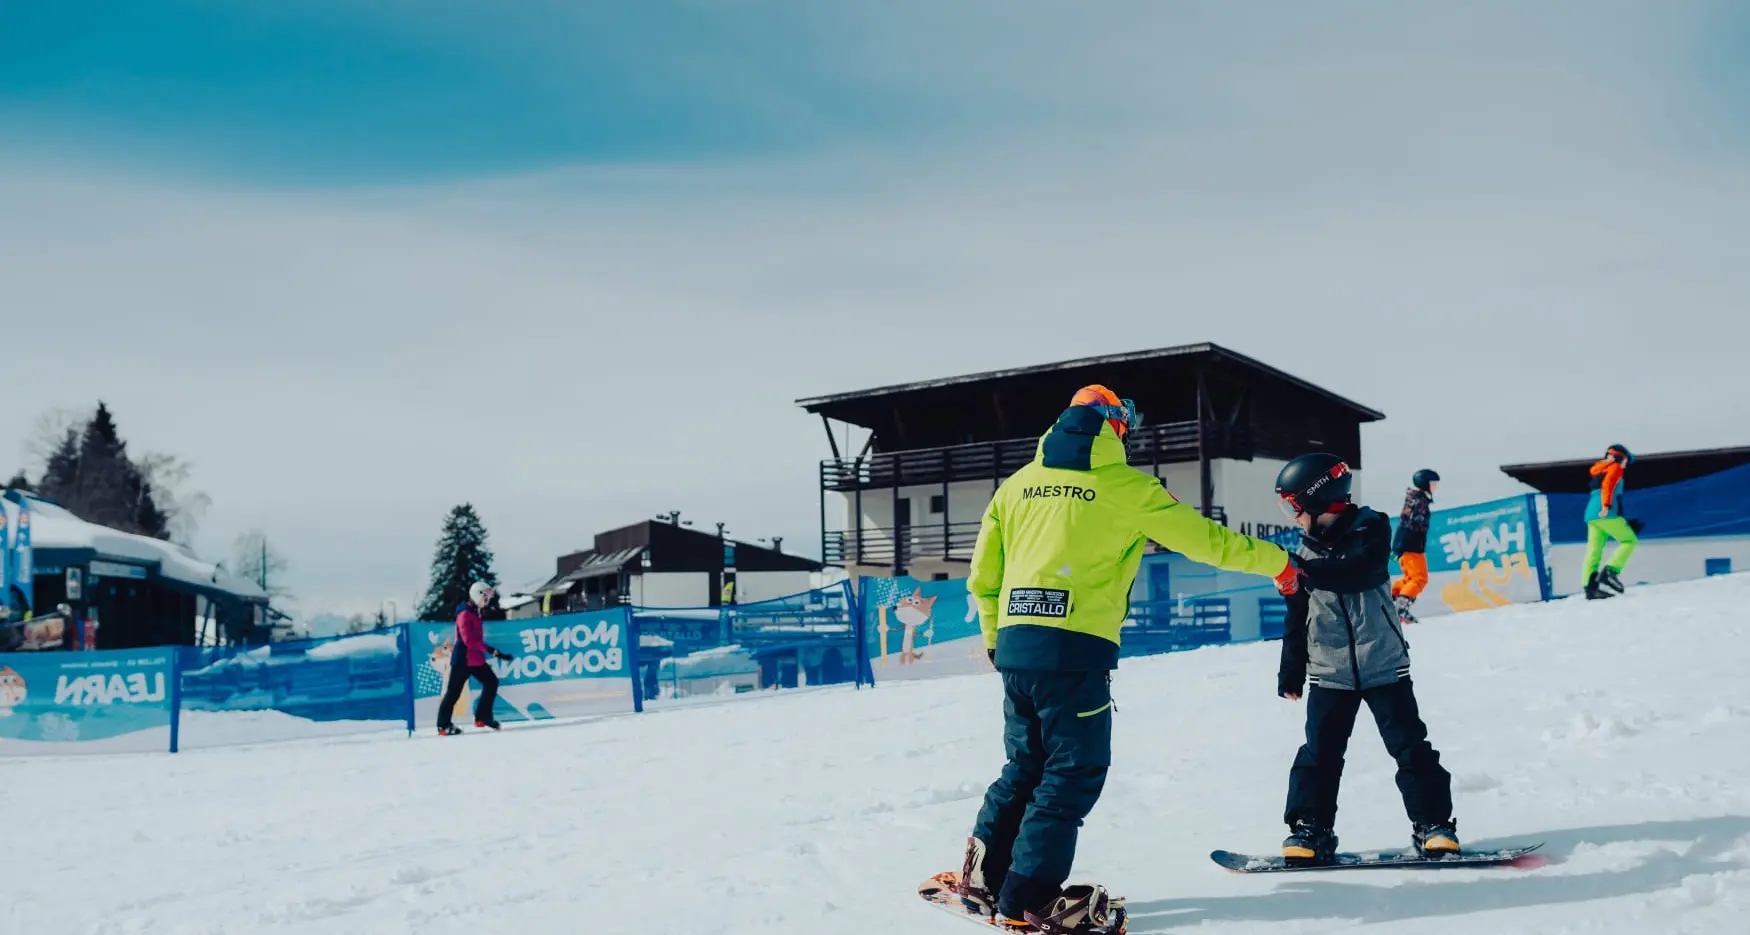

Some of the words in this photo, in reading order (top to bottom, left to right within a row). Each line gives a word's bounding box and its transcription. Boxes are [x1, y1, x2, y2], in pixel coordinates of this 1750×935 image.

[1022, 485, 1096, 502] MAESTRO
[1306, 475, 1330, 496] SMITH
[1008, 602, 1065, 616] CRISTALLO
